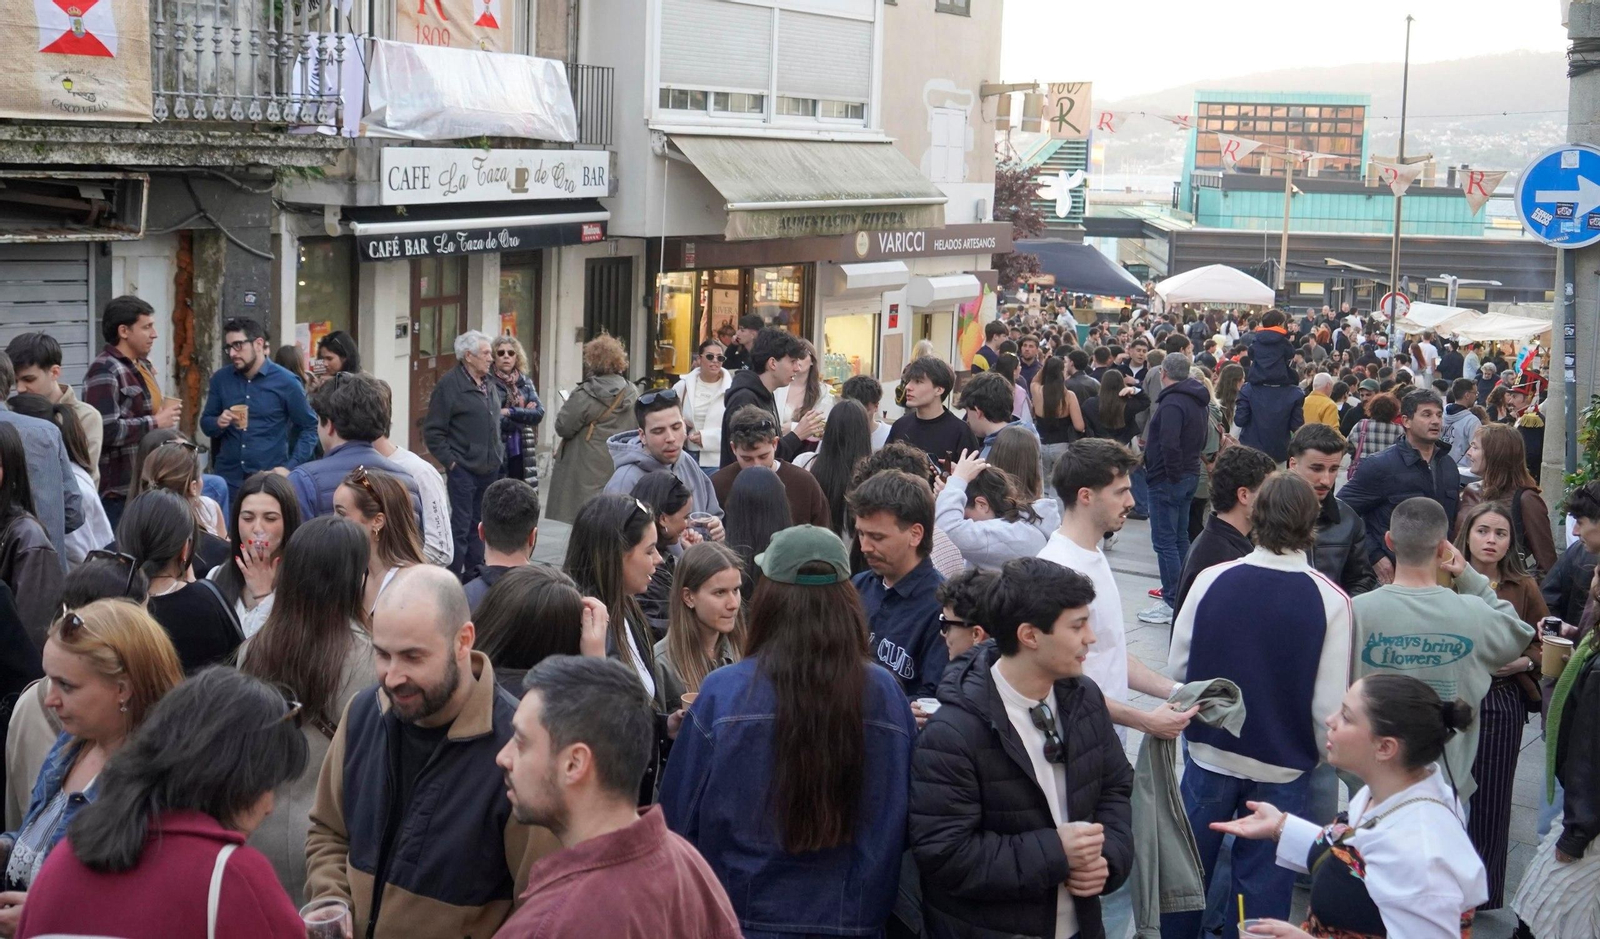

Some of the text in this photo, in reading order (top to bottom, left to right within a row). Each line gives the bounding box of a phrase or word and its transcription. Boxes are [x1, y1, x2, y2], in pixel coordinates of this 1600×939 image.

[51, 98, 109, 114] CASCO VELLO
[1050, 96, 1081, 135] R
[1098, 112, 1116, 134] R
[1221, 139, 1240, 162] R
[388, 156, 605, 197] CAFE La Taza de Oro BAR
[1466, 170, 1490, 197] R
[368, 228, 520, 259] CAFÉ BAR La Taza de Oro
[878, 231, 925, 254] VARICCI
[934, 239, 962, 251] HELADOS
[963, 237, 996, 250] ARTESANOS
[1365, 632, 1463, 656] Always bring
[1381, 646, 1442, 665] flowers
[877, 637, 915, 680] CLUB
